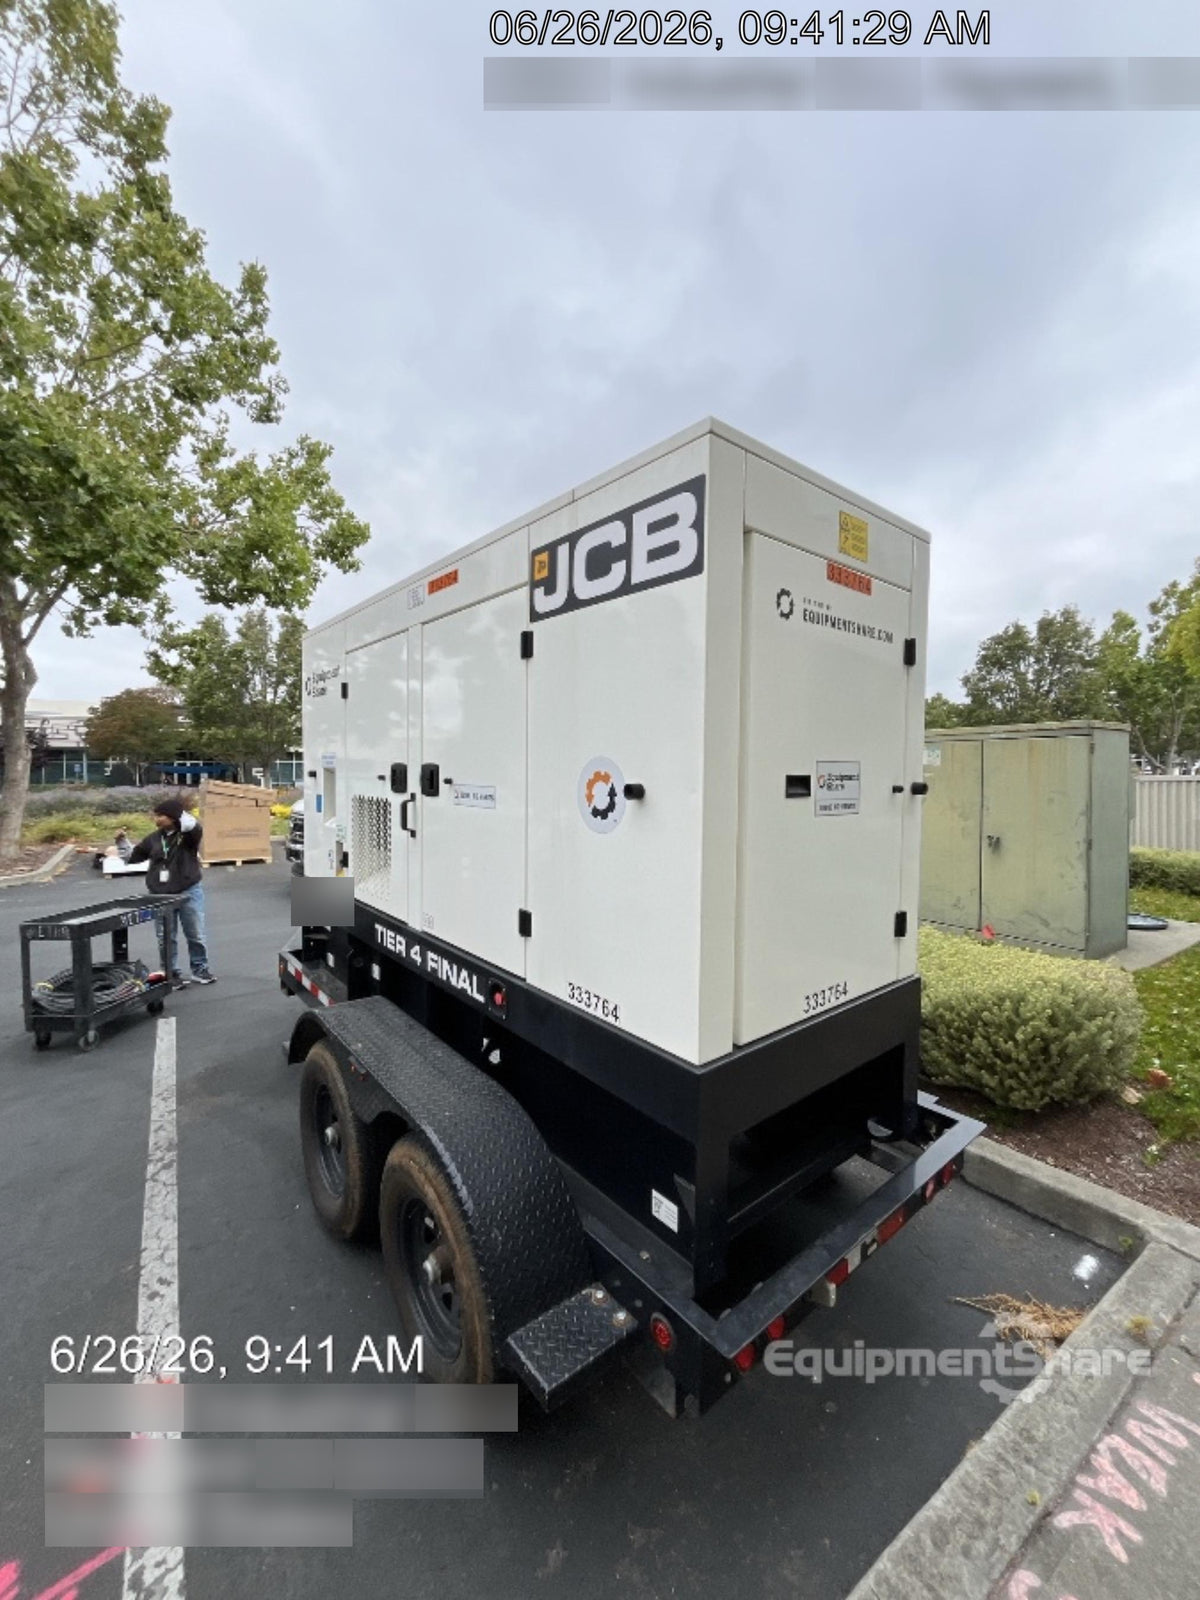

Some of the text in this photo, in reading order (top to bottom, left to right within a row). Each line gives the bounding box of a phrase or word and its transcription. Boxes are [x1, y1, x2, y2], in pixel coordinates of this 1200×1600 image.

[532, 491, 699, 614] JCB
[375, 923, 485, 1003] TIER 4 FINAL
[568, 982, 620, 1022] 333764
[803, 981, 848, 1014] 333764
